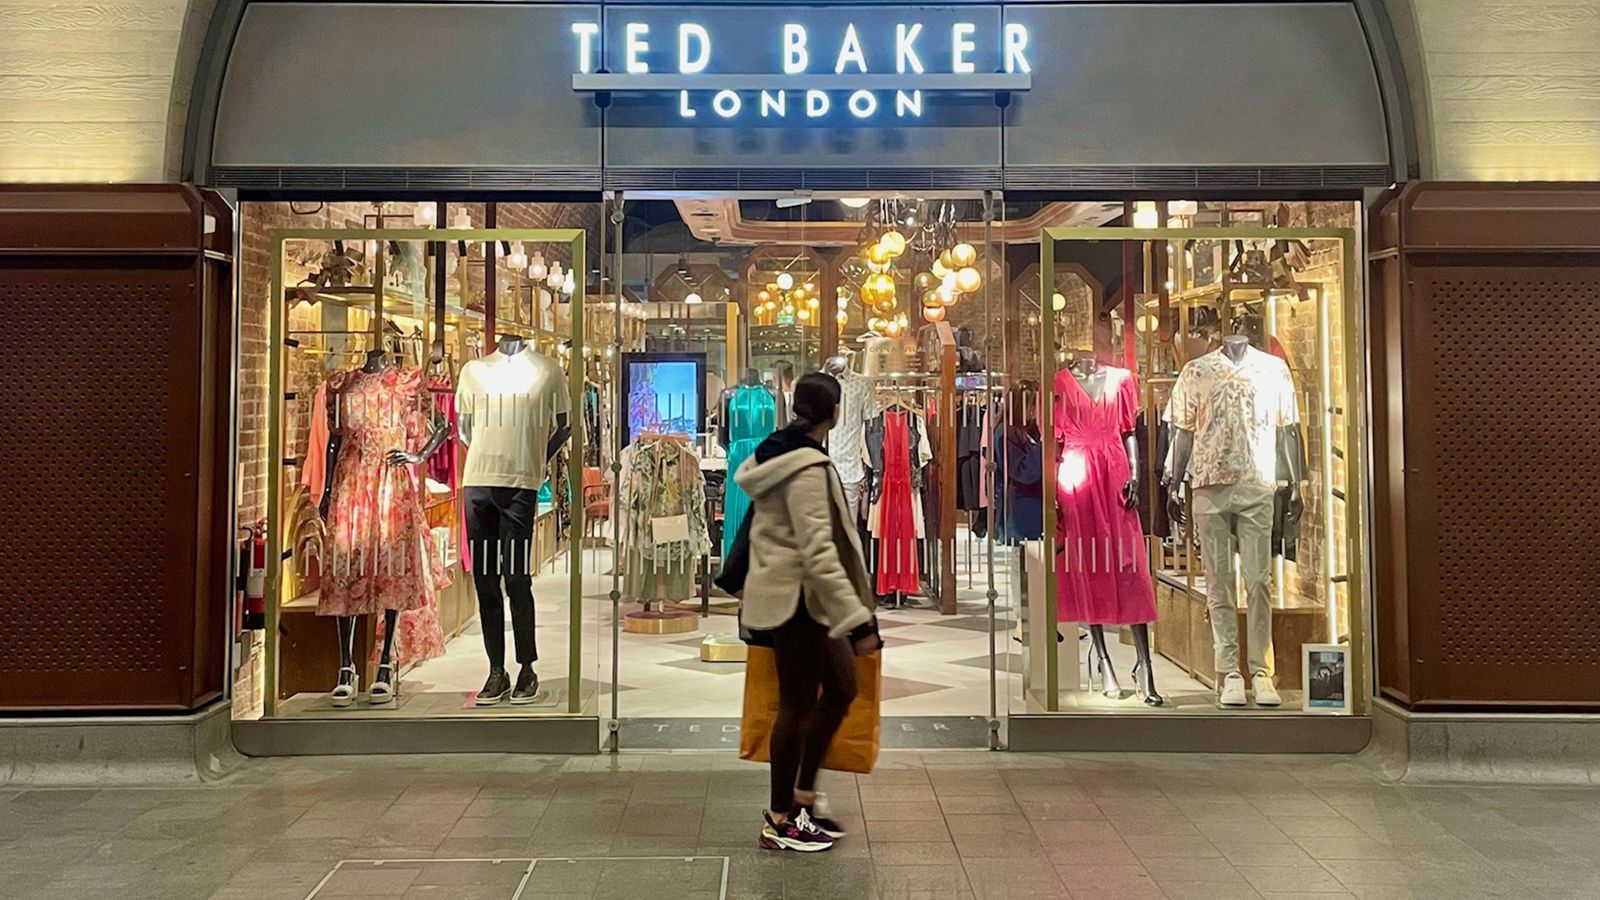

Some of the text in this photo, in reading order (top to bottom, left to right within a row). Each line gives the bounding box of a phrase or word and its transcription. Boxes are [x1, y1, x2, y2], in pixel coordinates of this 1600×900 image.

[571, 23, 1032, 74] TED BAKER
[679, 89, 922, 118] LONDON
[653, 724, 740, 733] TED
